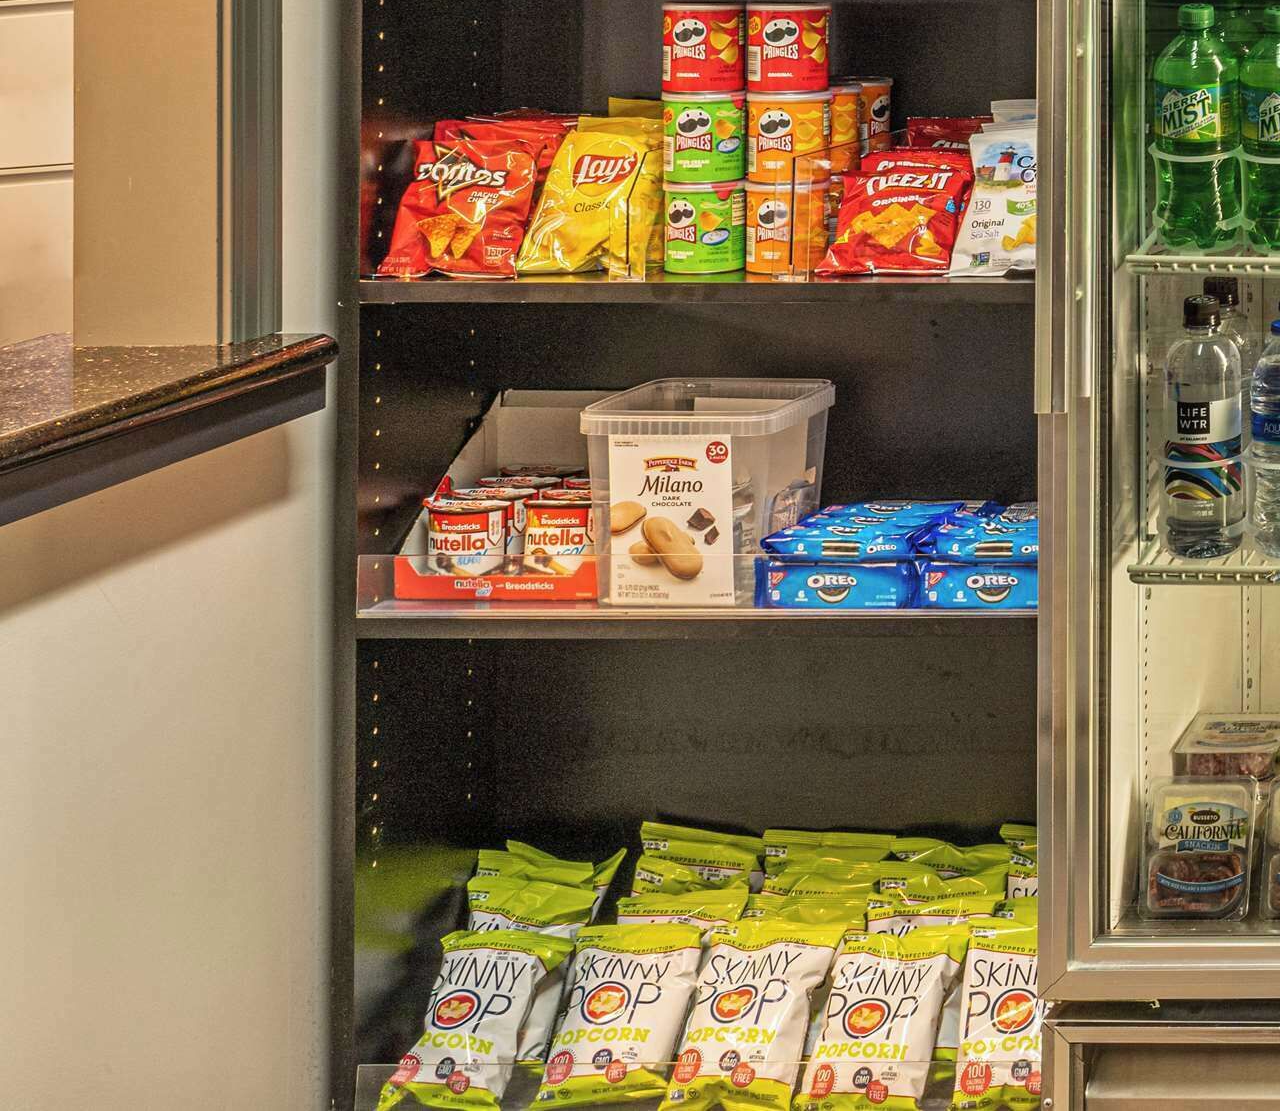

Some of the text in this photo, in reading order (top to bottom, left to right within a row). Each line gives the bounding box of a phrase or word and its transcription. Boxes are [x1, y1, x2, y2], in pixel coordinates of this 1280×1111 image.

[672, 45, 706, 61] PRINGLES
[762, 45, 799, 61] PRINGLES
[1161, 89, 1209, 113] SIERRA
[1161, 98, 1212, 135] MIST
[416, 160, 507, 188] Doritos
[575, 151, 640, 186] Lay's
[573, 199, 612, 215] Classic
[973, 198, 992, 211] 130
[970, 218, 1005, 230] Original
[1178, 406, 1208, 418] LIFE
[1178, 418, 1209, 430] WTR
[708, 445, 726, 457] 30
[637, 474, 704, 497] Milano
[527, 528, 585, 547] nutella
[504, 581, 555, 591] Breadsticks
[806, 574, 858, 588] OREO
[965, 573, 1020, 589] OREO
[1163, 822, 1242, 841] CALIFORNIA
[703, 950, 803, 986] SKINNY
[832, 961, 933, 998] SKINNY
[815, 1041, 909, 1060] POPCORN
[733, 1071, 752, 1085] FREE
